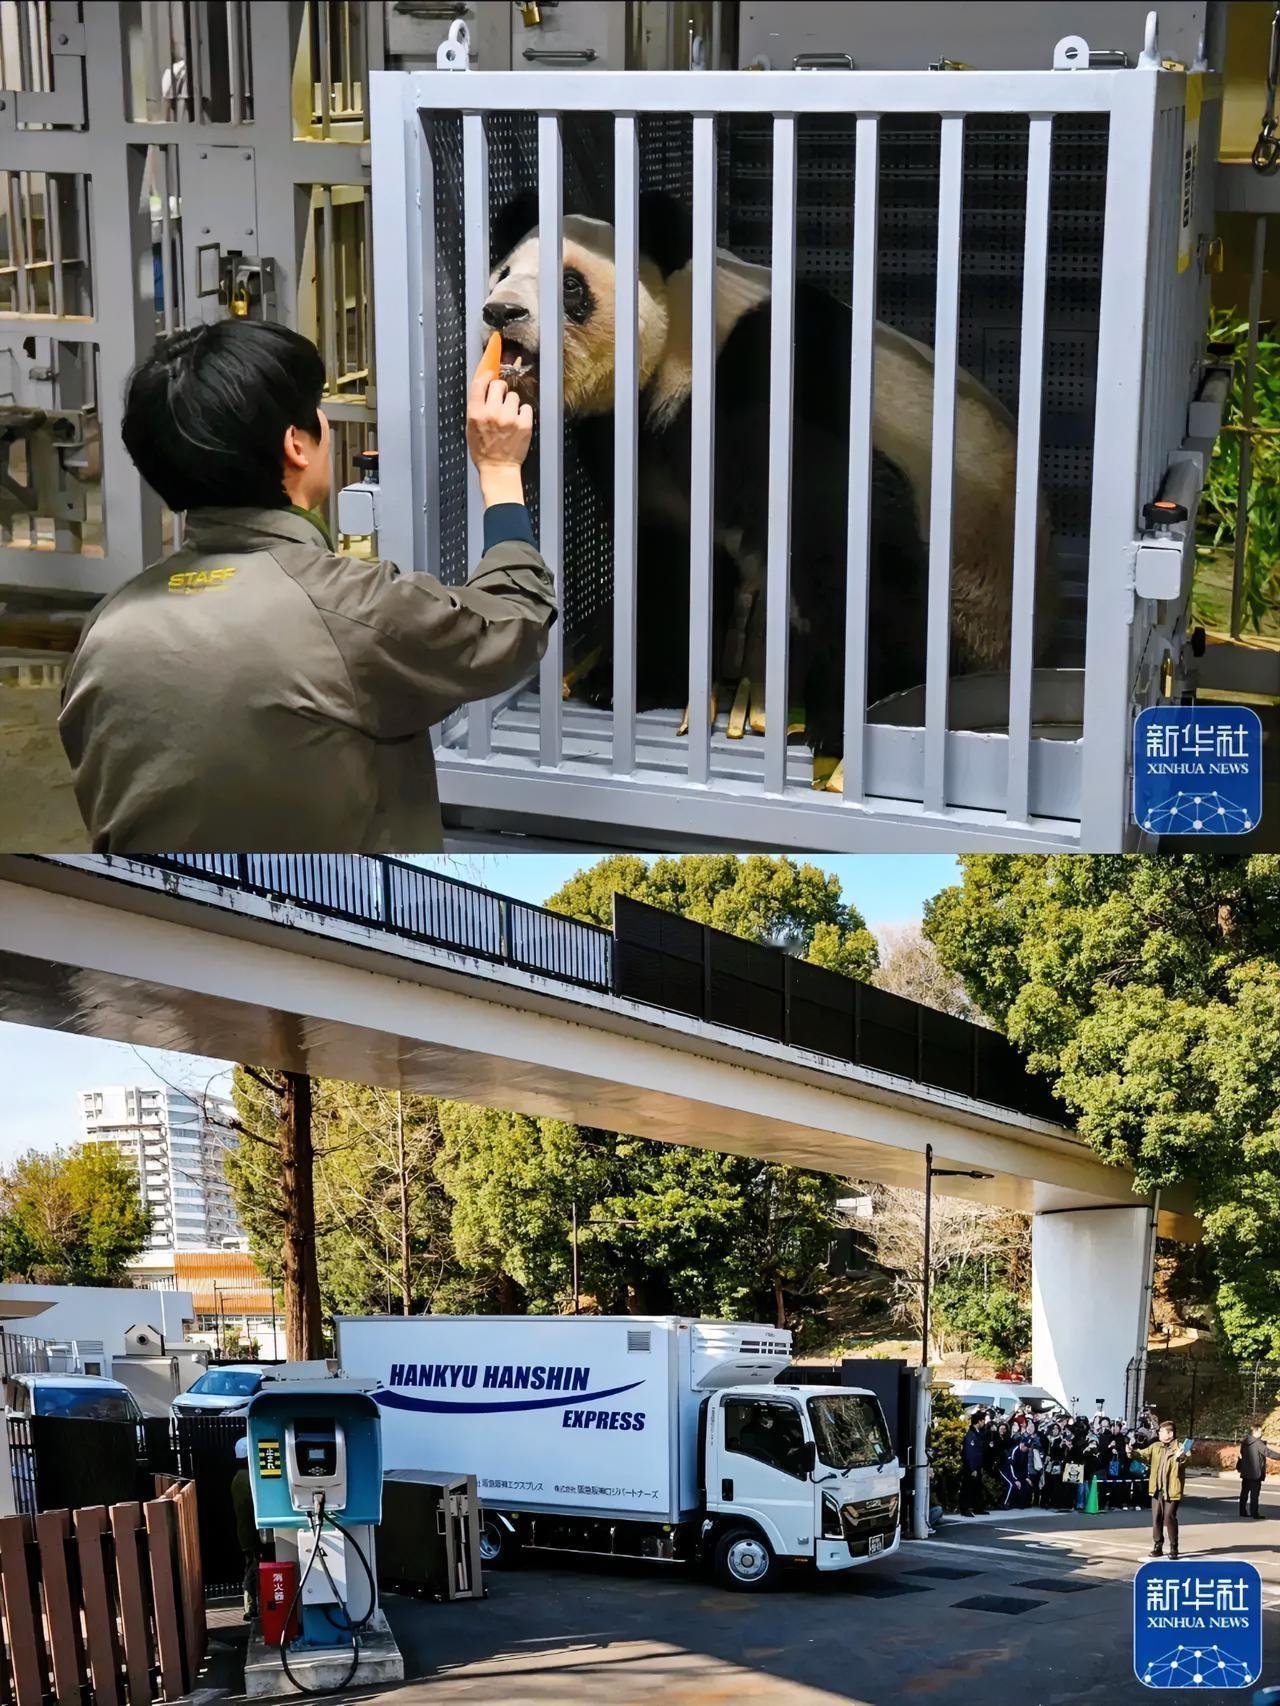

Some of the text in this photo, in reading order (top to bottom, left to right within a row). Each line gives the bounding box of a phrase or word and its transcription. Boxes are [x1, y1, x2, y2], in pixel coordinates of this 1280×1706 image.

[168, 567, 237, 587] STAFF
[389, 1364, 590, 1391] HANKYU HANSHIN
[562, 1410, 646, 1431] EXPRESS
